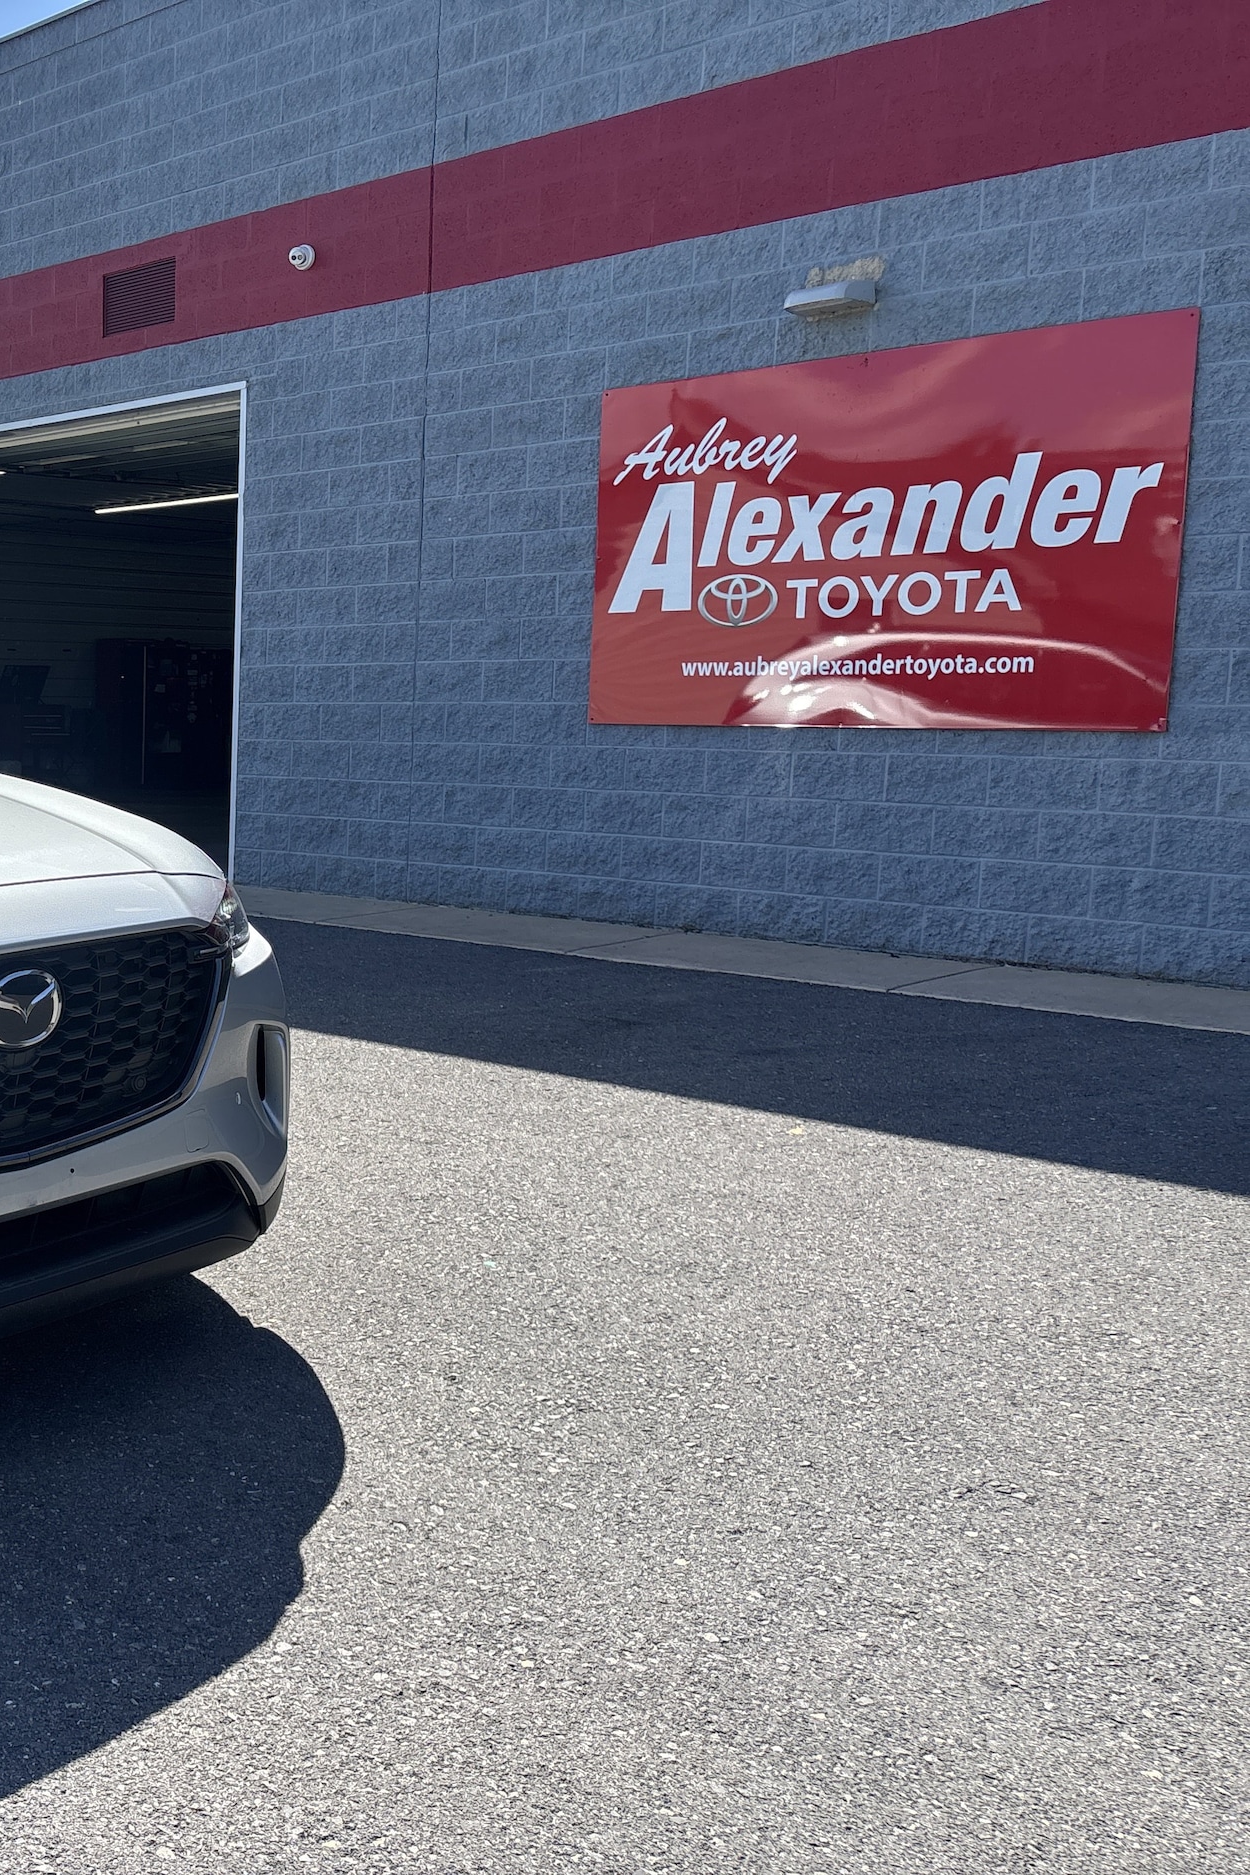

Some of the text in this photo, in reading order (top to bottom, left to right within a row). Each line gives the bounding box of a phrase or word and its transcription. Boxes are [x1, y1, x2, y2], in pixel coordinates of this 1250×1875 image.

[613, 417, 799, 486] Aubrey
[607, 452, 1165, 615] Alexander
[786, 569, 1022, 619] TOYOTA
[681, 653, 1035, 680] www.aubreyalexandertoyota.com
